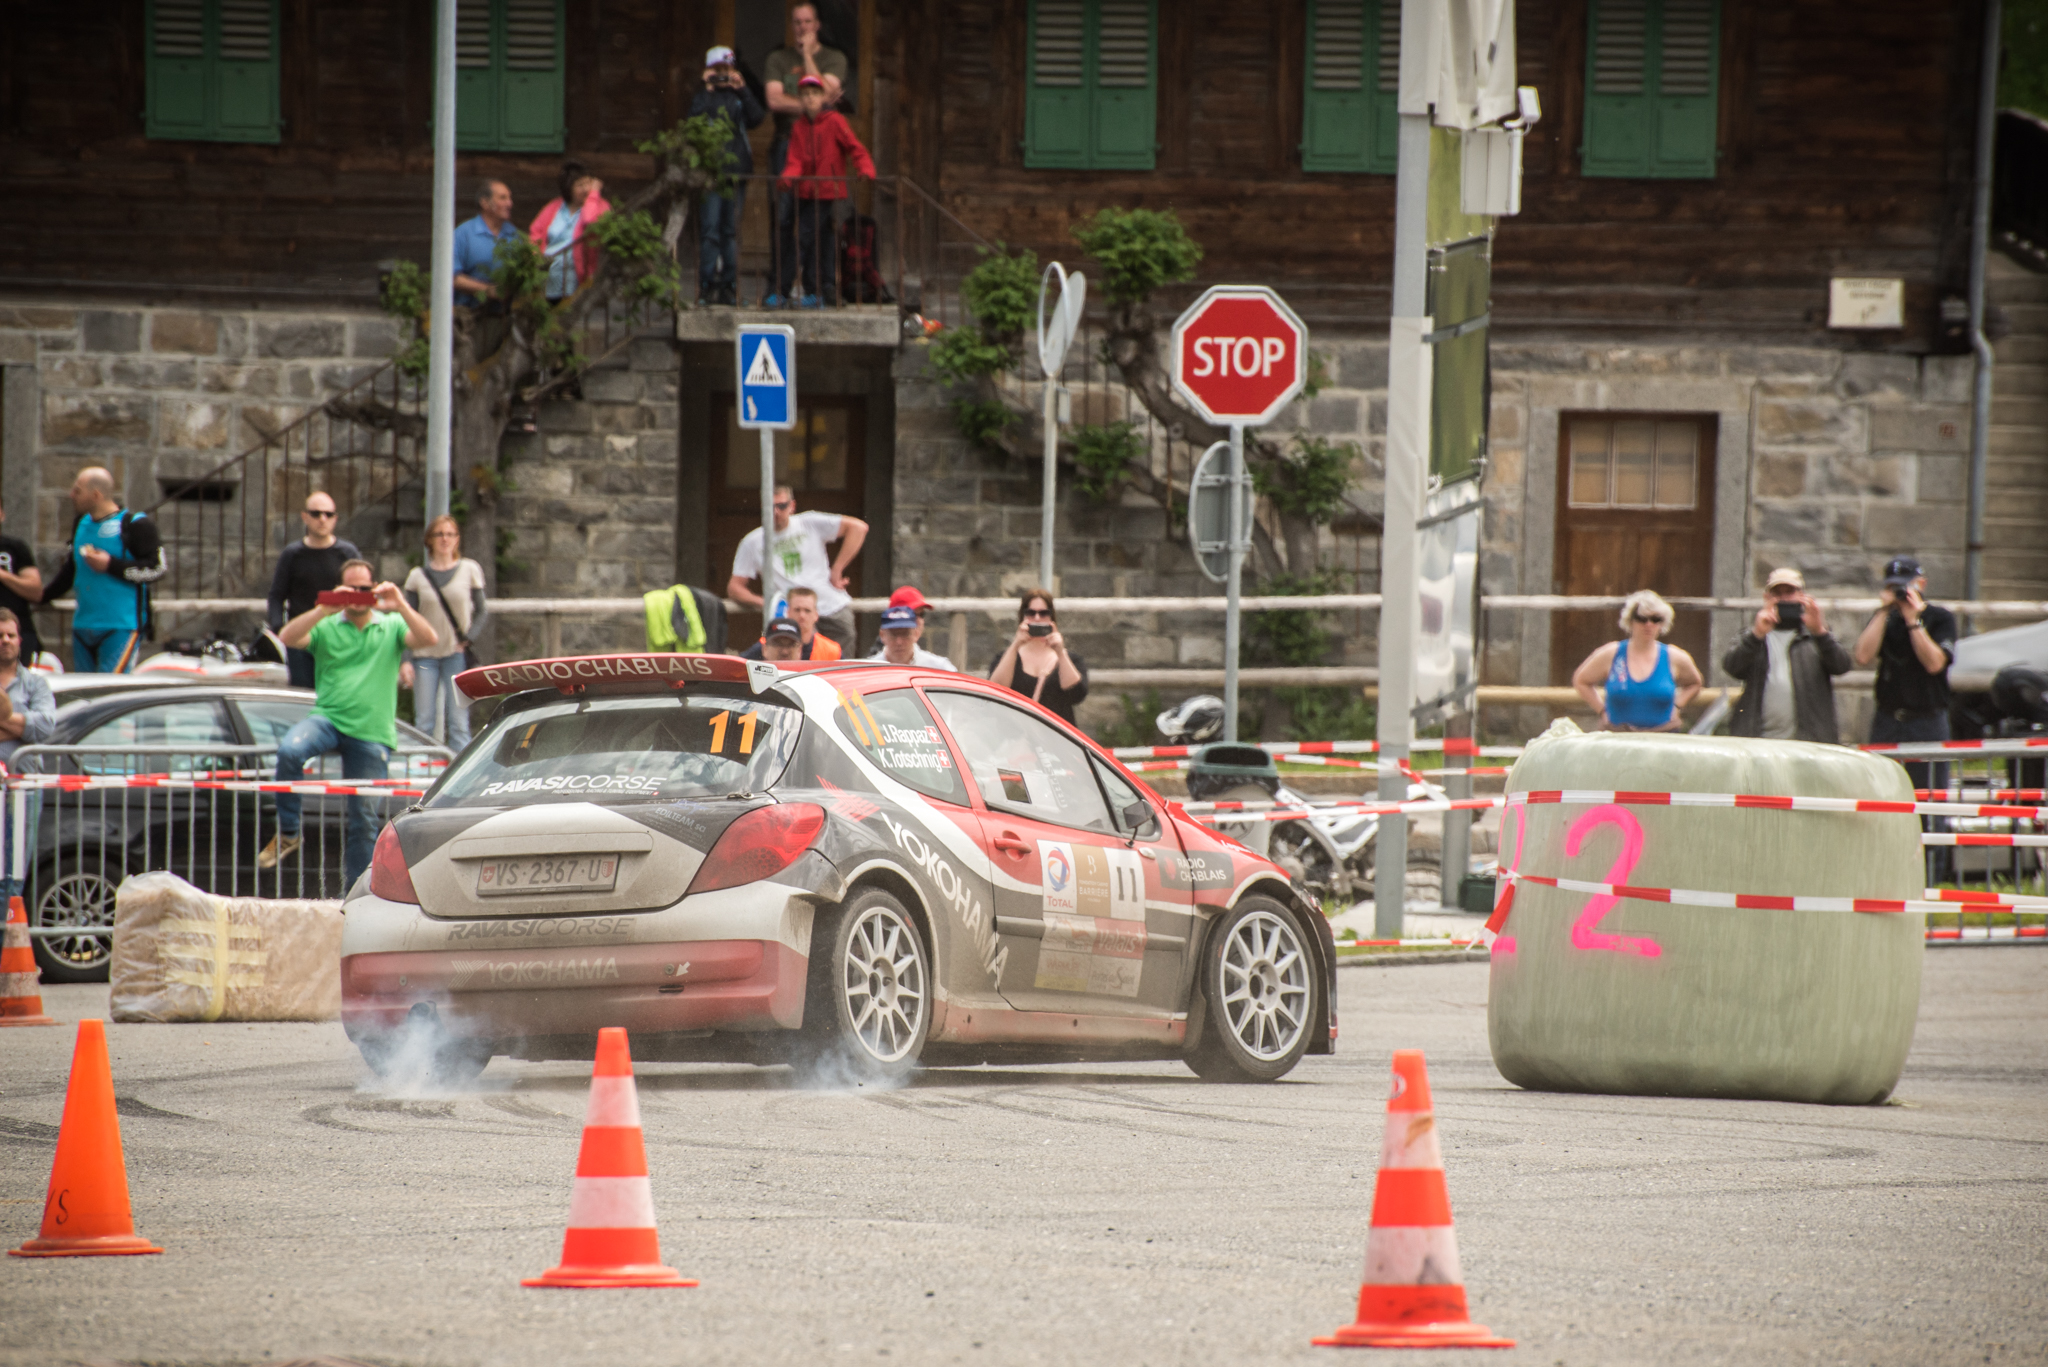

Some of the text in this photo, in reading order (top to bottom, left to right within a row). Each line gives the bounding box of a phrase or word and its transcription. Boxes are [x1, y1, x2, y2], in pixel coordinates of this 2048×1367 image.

[1193, 336, 1286, 377] STOP
[483, 658, 712, 687] RADIO CHABLAIS
[836, 688, 886, 747] 11
[708, 710, 758, 754] 11
[881, 724, 931, 747] J.Rappaz
[877, 747, 943, 773] K.Totschnig
[479, 774, 667, 797] RAVASICORSE
[496, 859, 602, 886] VS 2367 U
[1176, 857, 1205, 869] RADIO
[1180, 869, 1226, 882] CHABLAIS
[1116, 866, 1138, 903] 11
[1565, 803, 1662, 957] 2
[881, 812, 1009, 991] YOKOHAMA
[447, 918, 635, 941] RAVASICORSE
[488, 957, 619, 984] YOKOHAMA
